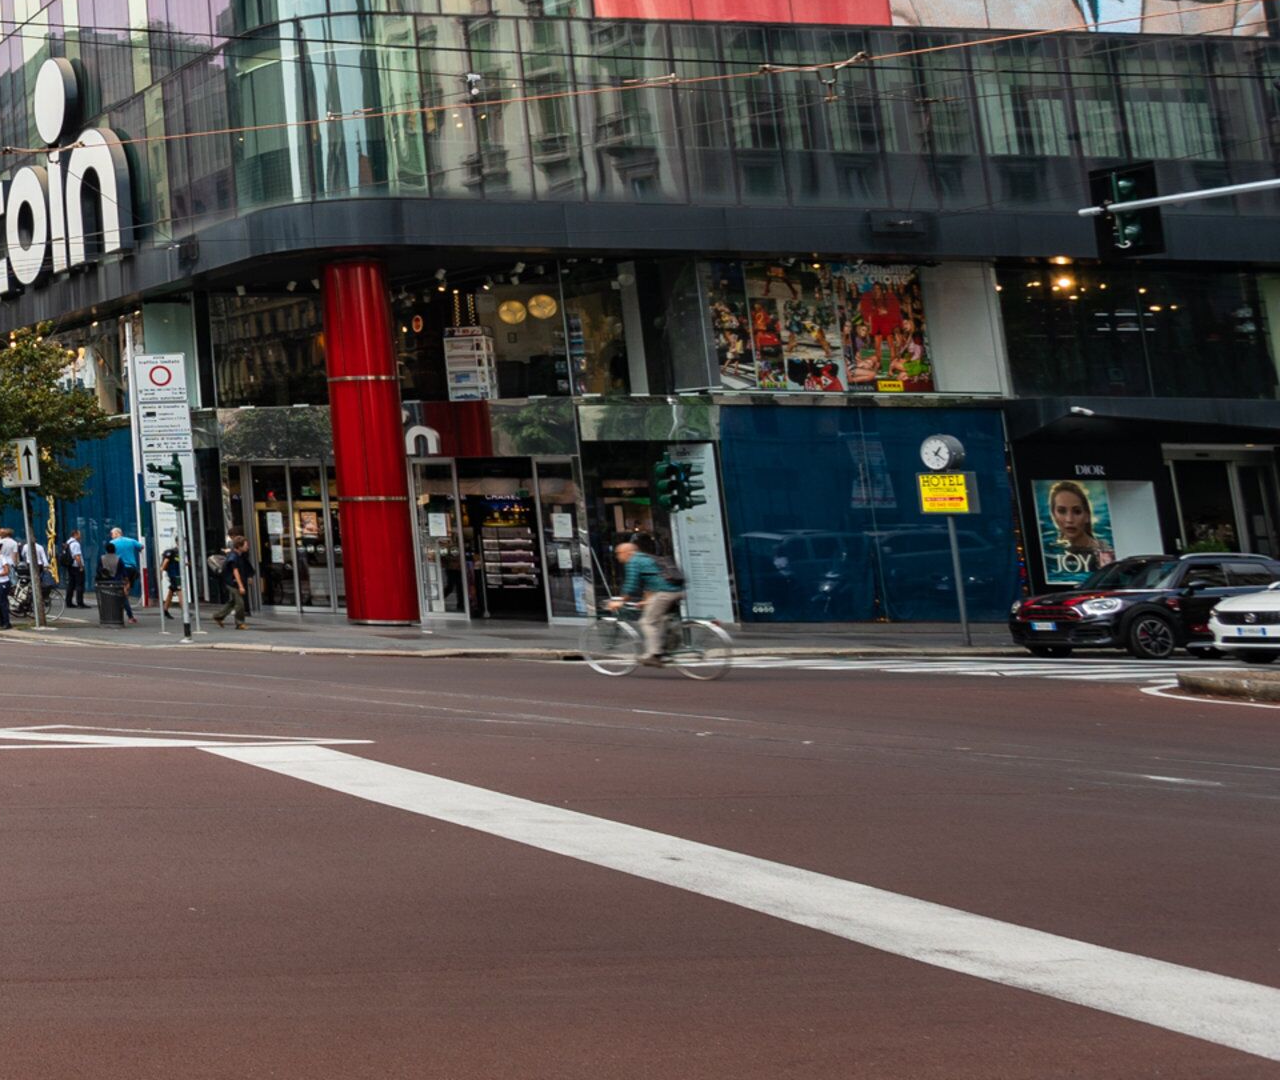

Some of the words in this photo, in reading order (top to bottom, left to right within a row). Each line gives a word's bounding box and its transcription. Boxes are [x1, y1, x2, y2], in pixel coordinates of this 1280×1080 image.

[1074, 464, 1107, 475] DIOR
[921, 475, 963, 487] HOTEL
[1052, 549, 1092, 574] JOY
